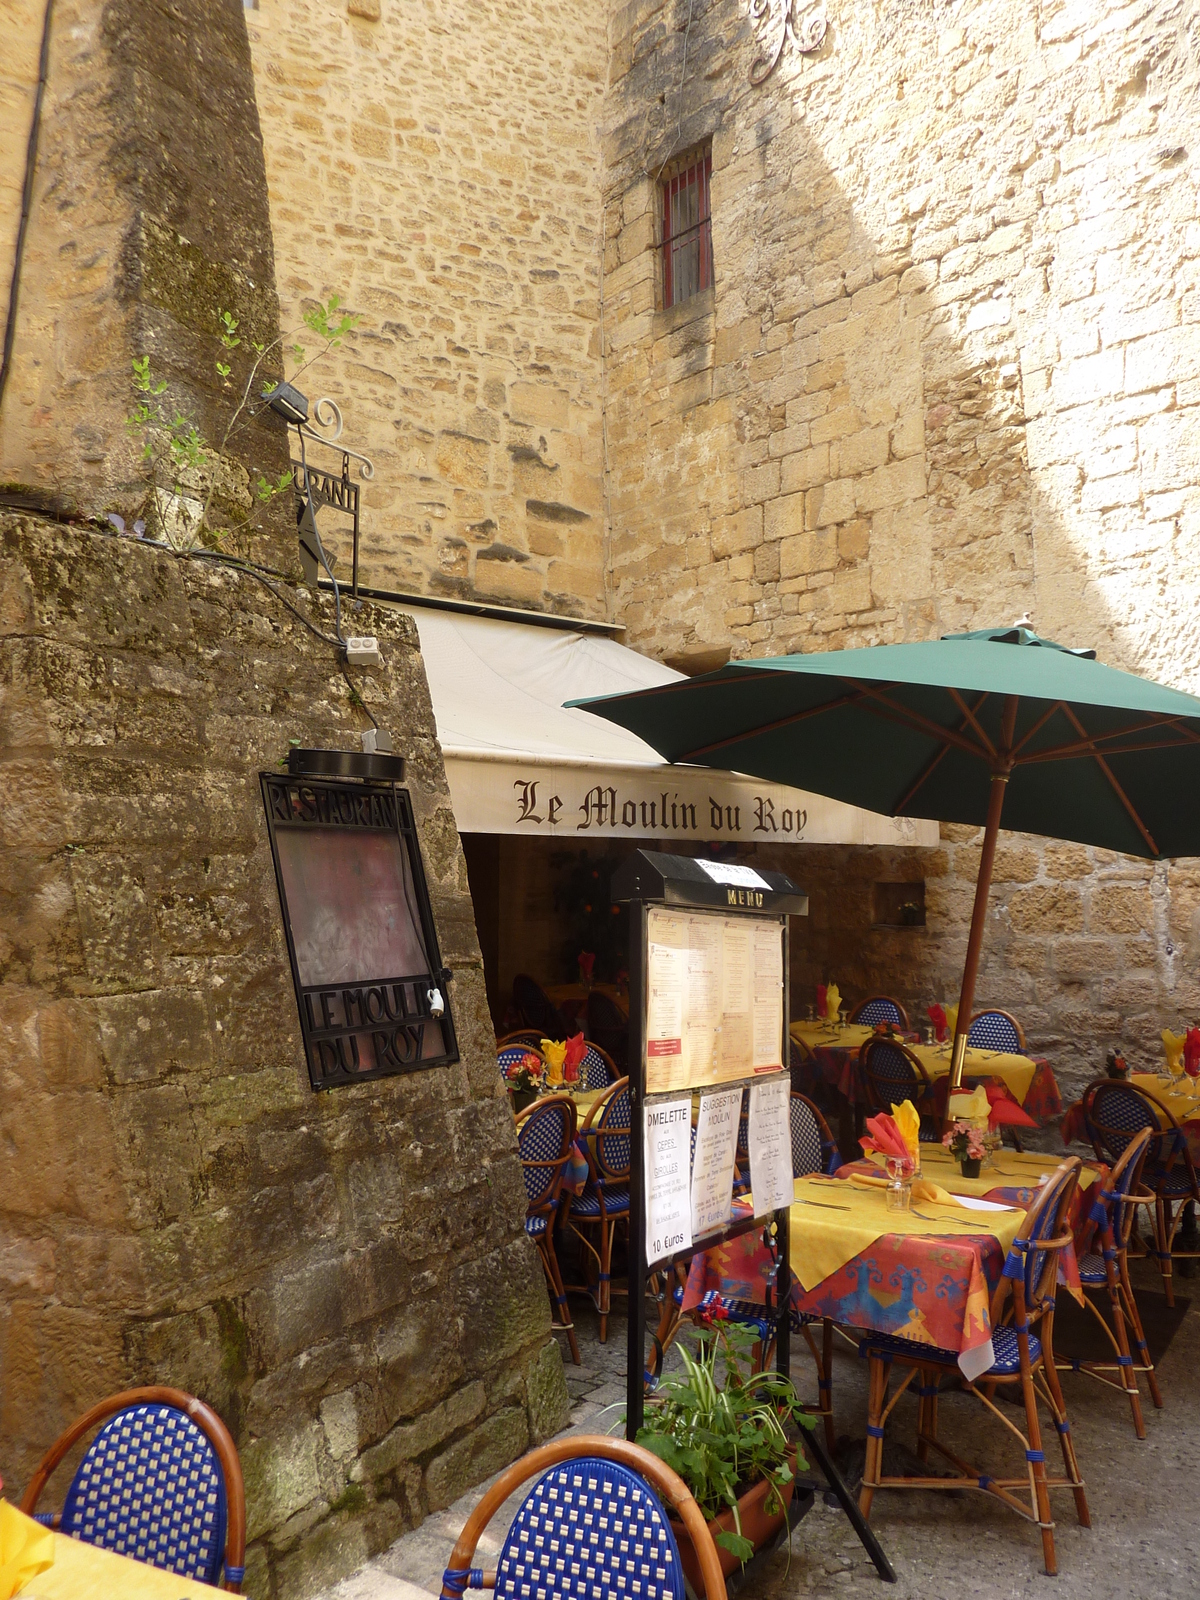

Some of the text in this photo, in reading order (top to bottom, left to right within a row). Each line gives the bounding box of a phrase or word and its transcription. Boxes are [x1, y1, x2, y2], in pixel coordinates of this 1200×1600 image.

[513, 780, 807, 840] Le Moulin du Roy
[727, 889, 763, 908] MENU
[304, 991, 342, 1032] LE
[317, 1023, 425, 1078] DU ROY
[702, 1093, 740, 1112] SUGGESTION
[648, 1108, 687, 1127] OMELETTE
[653, 1239, 661, 1254] 10
